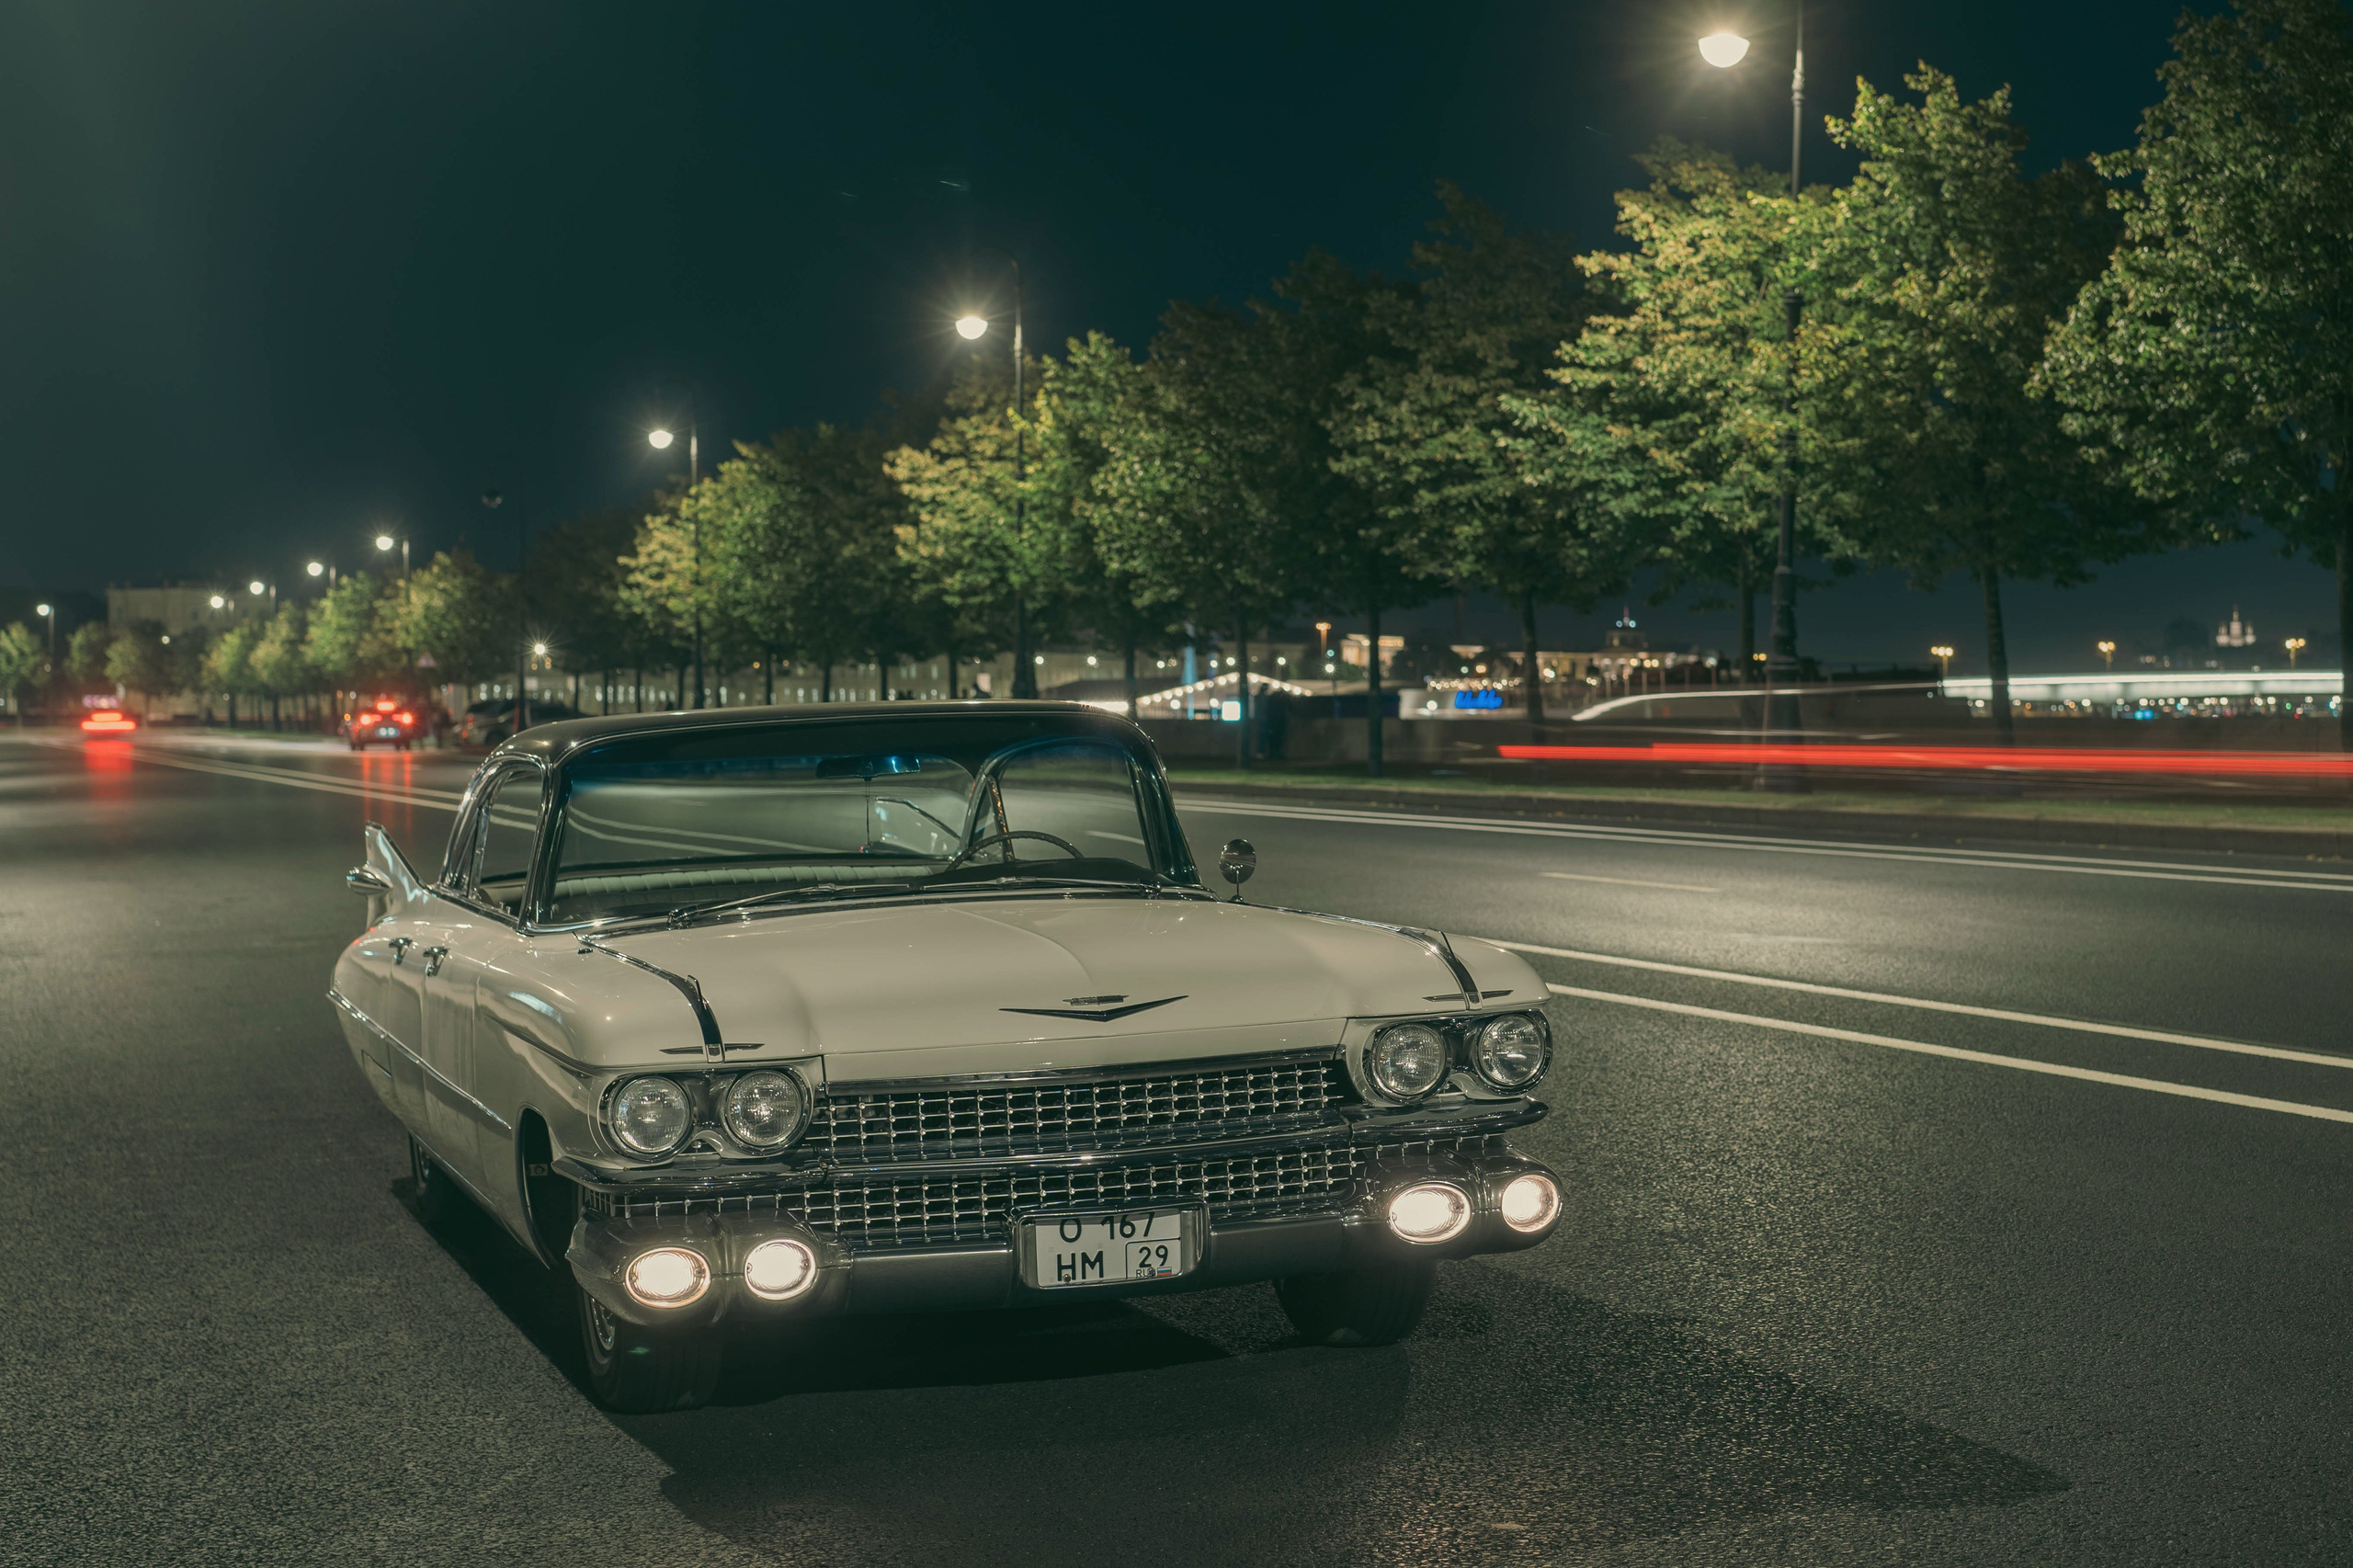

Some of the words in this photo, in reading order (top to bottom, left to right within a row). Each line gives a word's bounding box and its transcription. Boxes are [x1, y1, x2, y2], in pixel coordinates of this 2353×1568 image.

[1059, 1218, 1082, 1243] O
[1100, 1212, 1155, 1240] 167
[1057, 1251, 1104, 1281] HM
[1139, 1245, 1168, 1267] 29
[1136, 1268, 1155, 1278] RU
